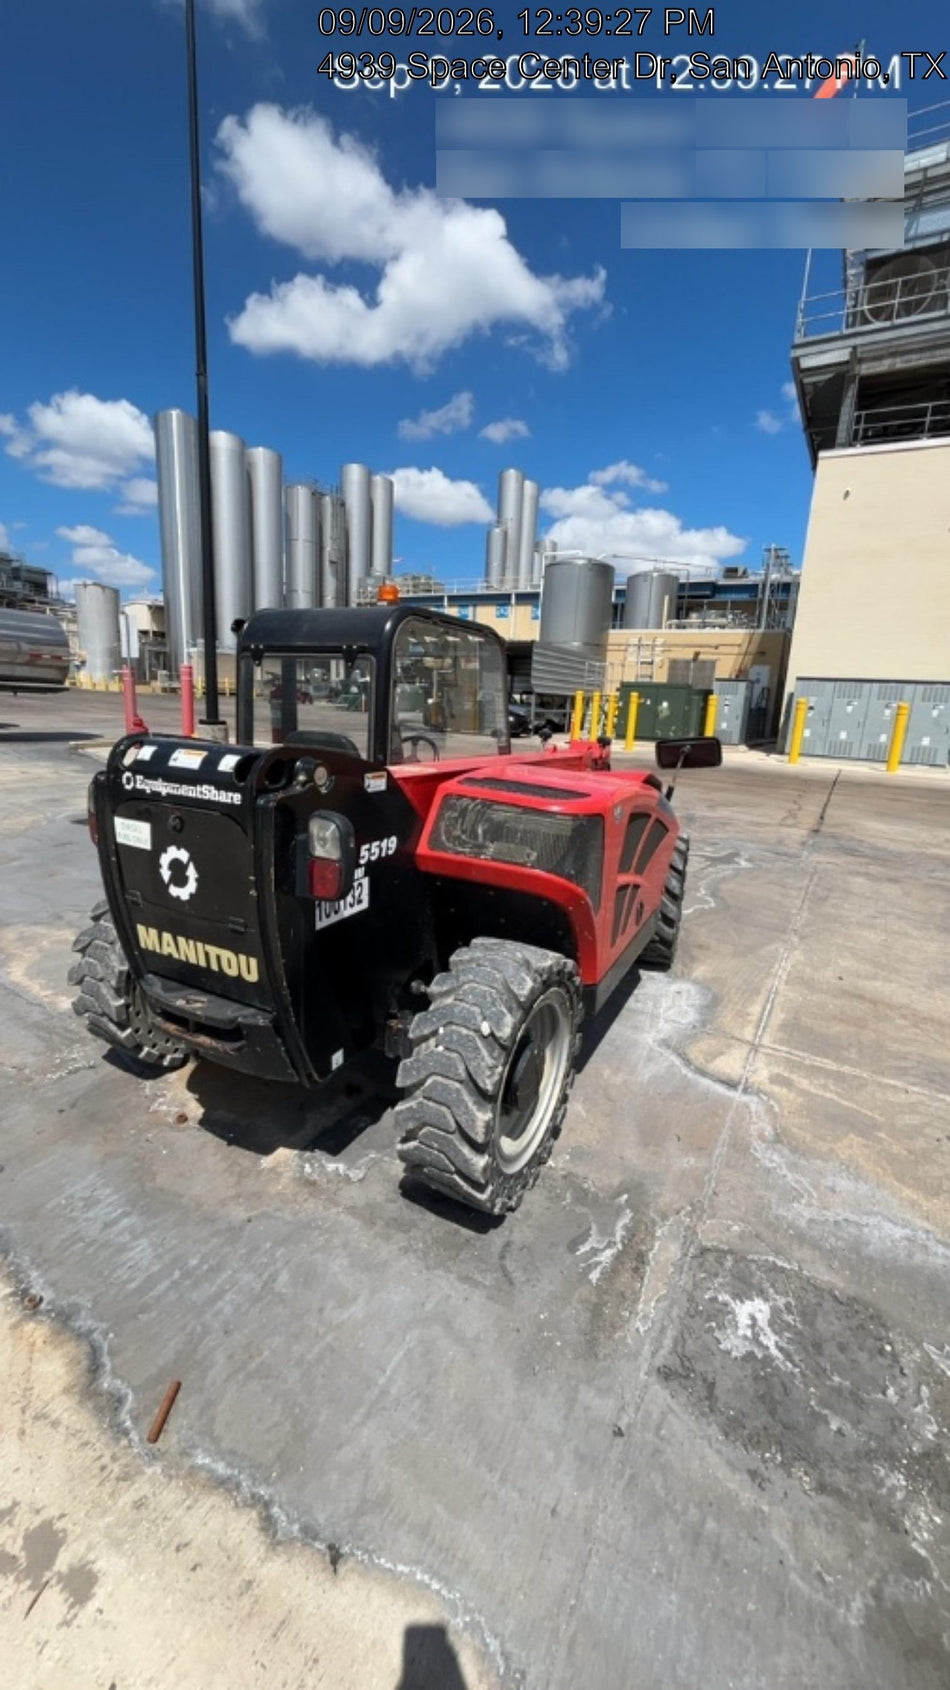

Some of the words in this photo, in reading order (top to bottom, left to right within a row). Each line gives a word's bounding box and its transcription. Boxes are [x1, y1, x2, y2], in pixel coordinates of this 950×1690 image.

[135, 774, 242, 805] EquipmentShare
[359, 835, 397, 865] 5519
[136, 922, 259, 983] MANITOU
